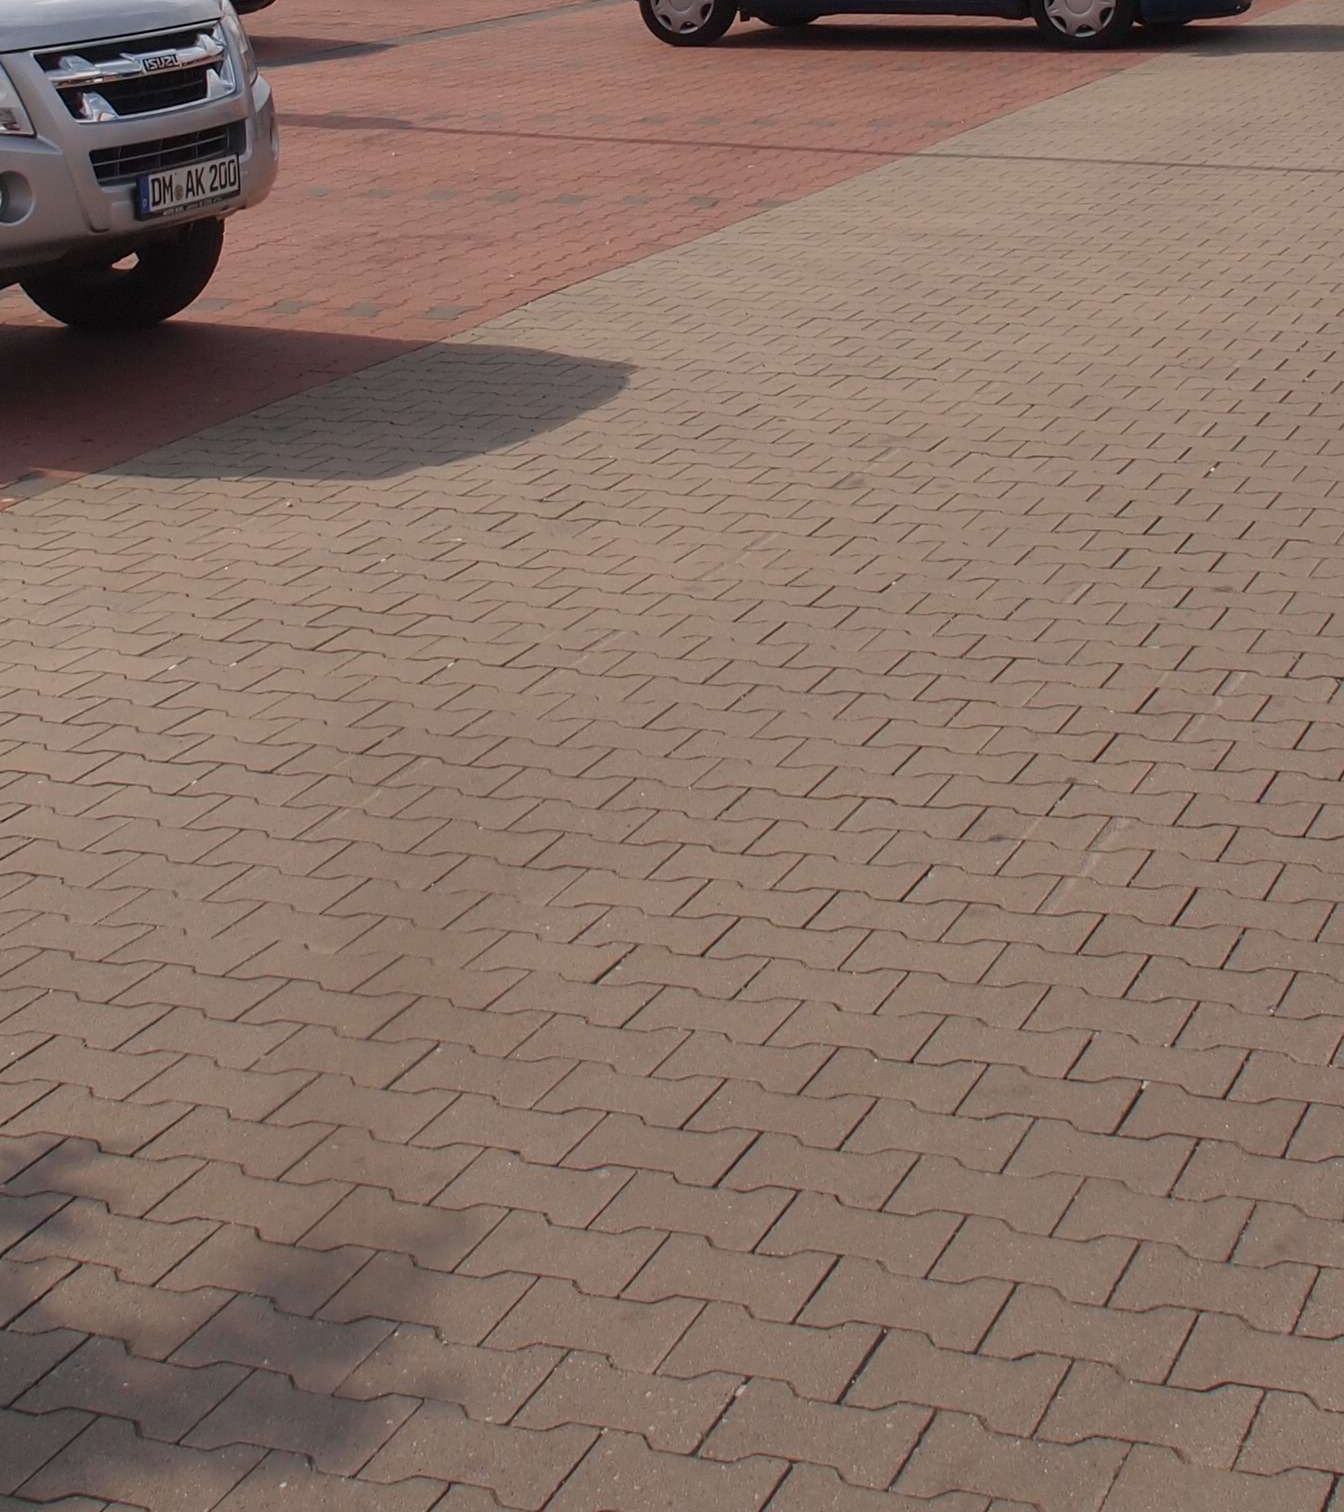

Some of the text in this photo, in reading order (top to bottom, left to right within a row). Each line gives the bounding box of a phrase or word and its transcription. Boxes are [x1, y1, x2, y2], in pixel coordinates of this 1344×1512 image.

[143, 55, 180, 71] ISUZU
[151, 174, 174, 207] DM
[185, 167, 206, 199] AK
[209, 158, 237, 193] 200
